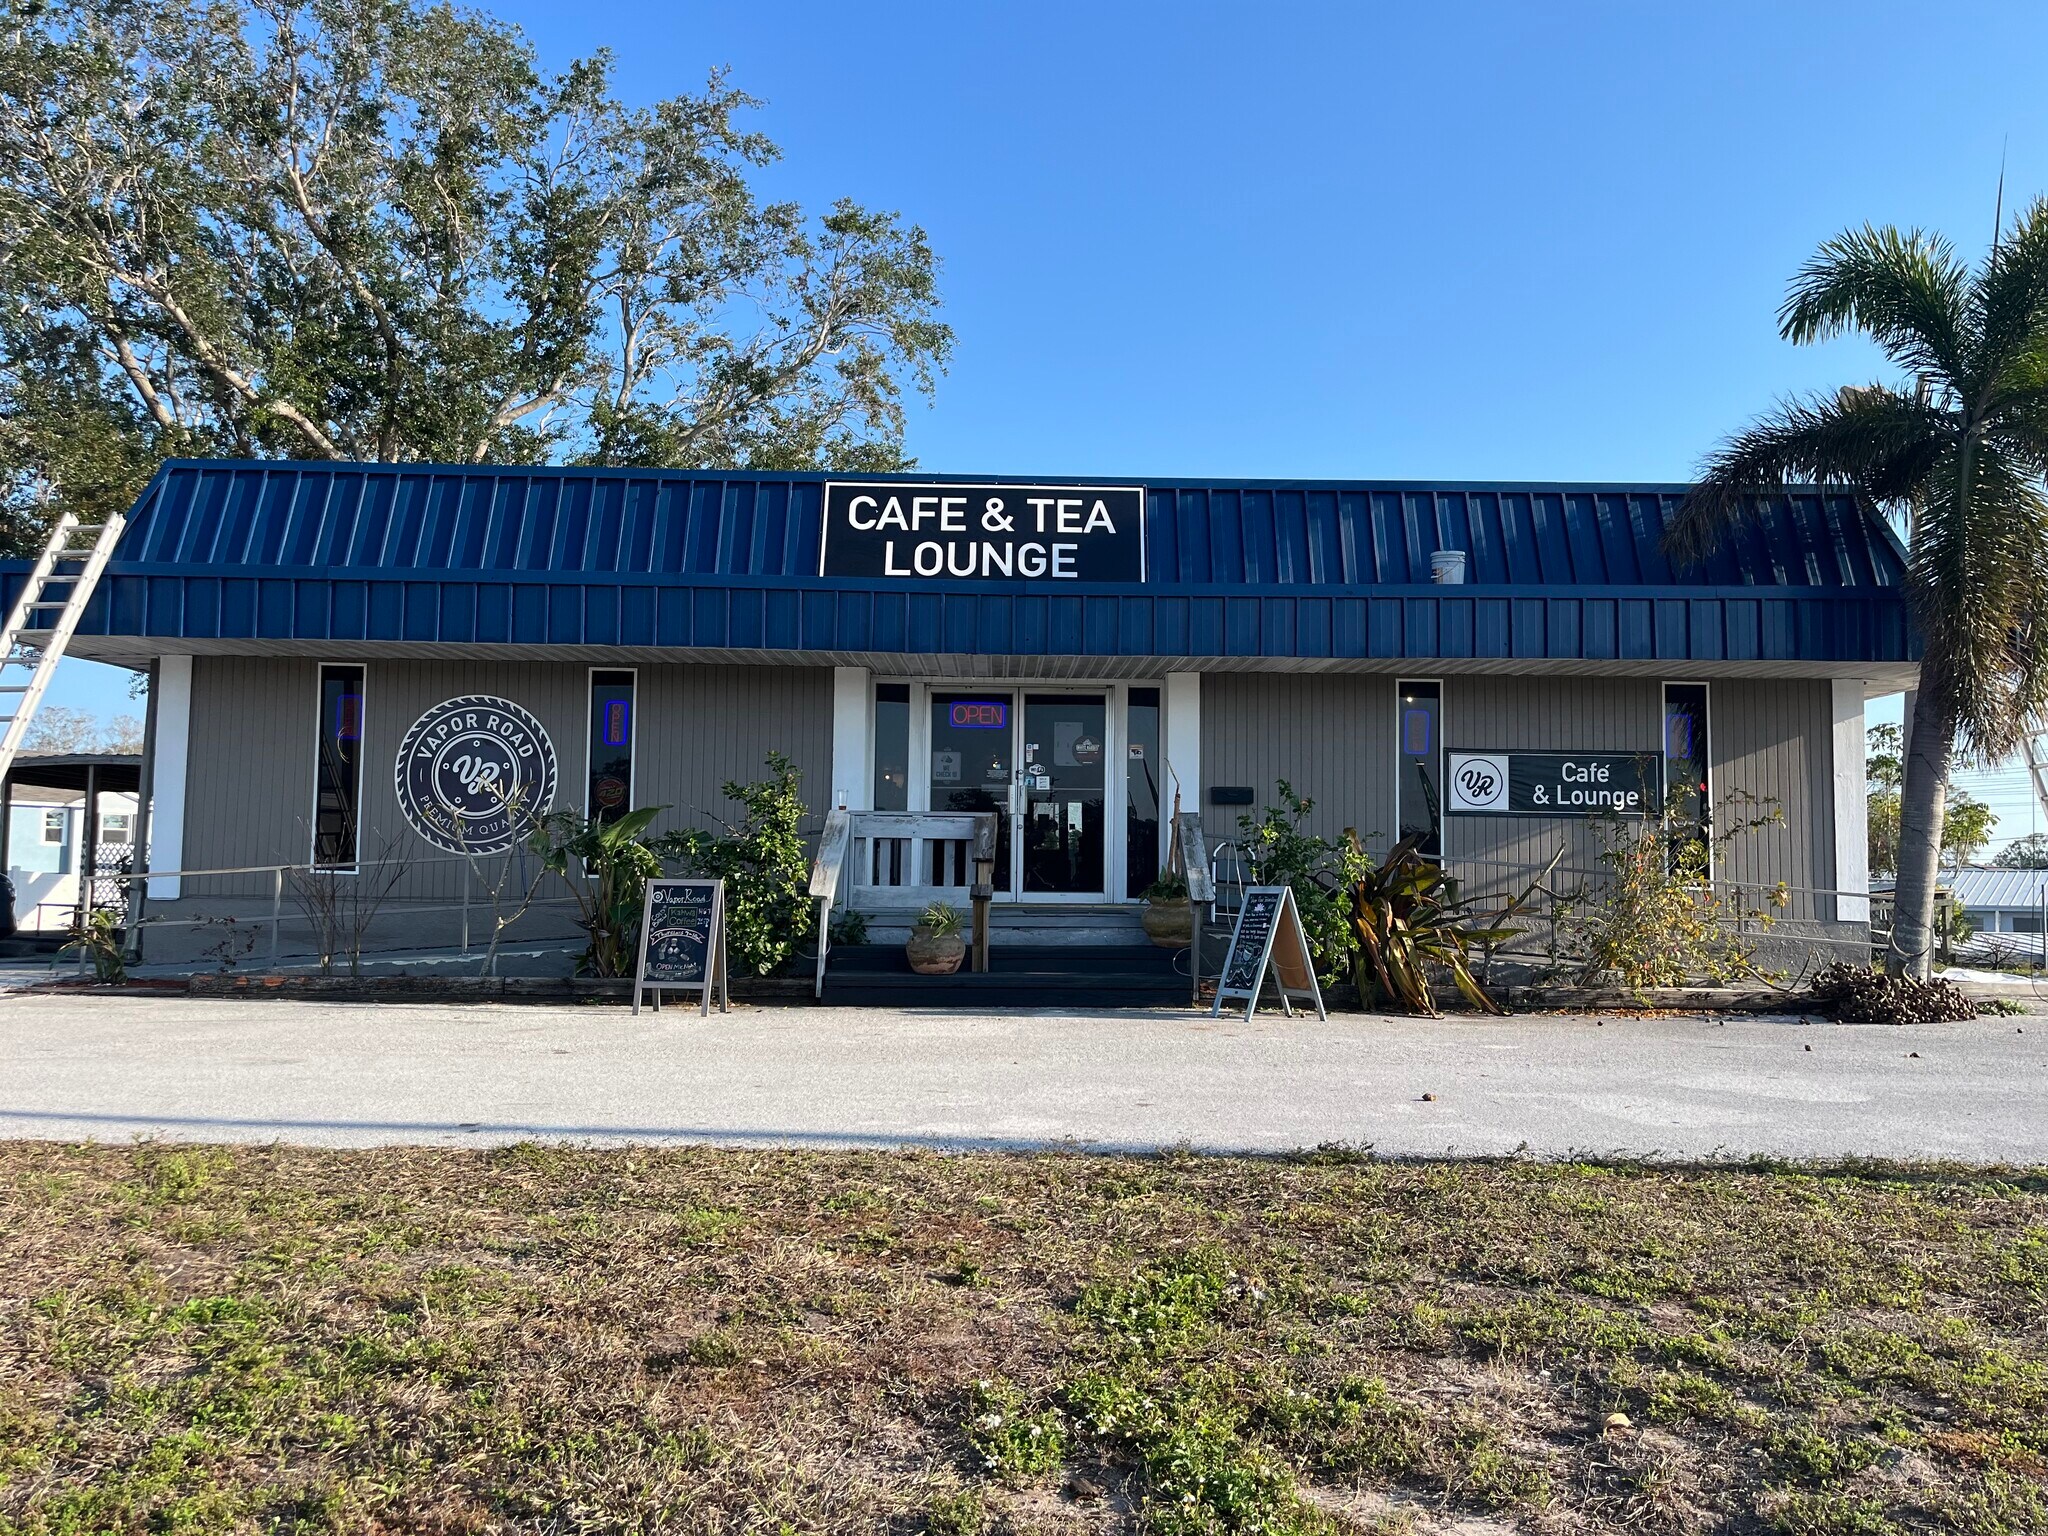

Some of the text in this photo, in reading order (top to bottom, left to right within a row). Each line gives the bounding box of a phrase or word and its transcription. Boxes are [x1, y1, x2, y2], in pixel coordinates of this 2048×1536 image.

[848, 495, 1116, 534] CAFE & TEA
[884, 541, 1078, 578] LOUNGE
[953, 704, 1003, 724] OPEN
[416, 713, 534, 760] VAPOR ROAD
[1561, 762, 1610, 783] Café
[1533, 784, 1639, 811] & Lounge
